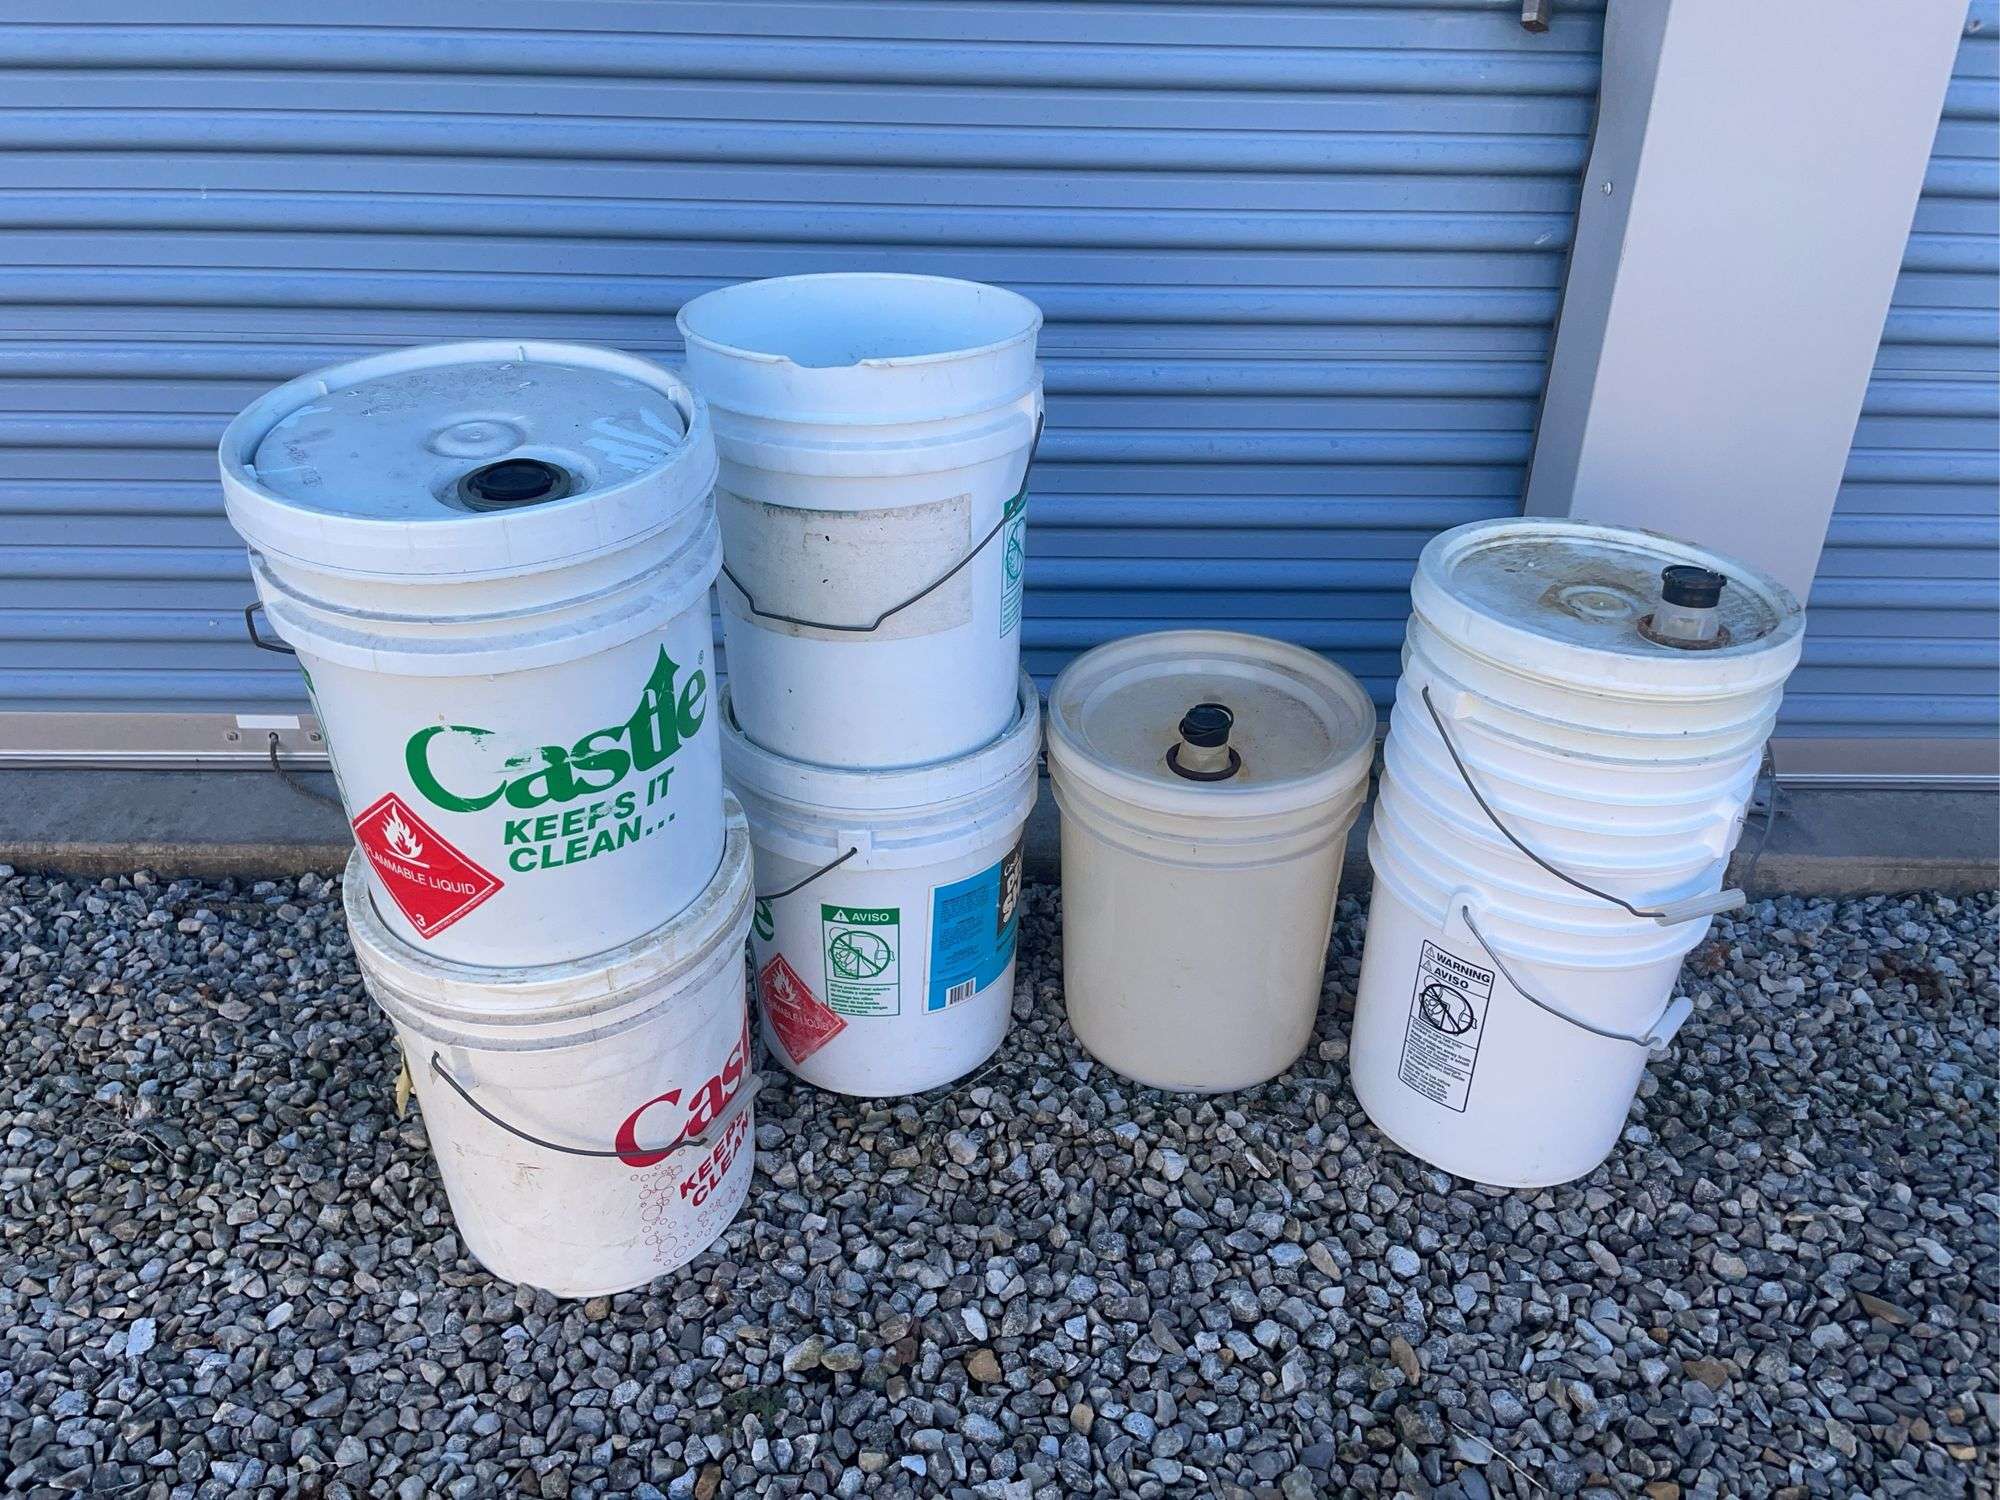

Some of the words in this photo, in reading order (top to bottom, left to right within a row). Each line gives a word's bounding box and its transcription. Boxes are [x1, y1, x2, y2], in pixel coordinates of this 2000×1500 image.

[405, 642, 708, 812] Castle
[503, 791, 636, 845] KEEPS
[646, 766, 675, 806] IT
[364, 841, 427, 886] FLAMMABLE
[428, 875, 476, 895] LIQUID
[414, 912, 427, 927] 3
[852, 912, 890, 923] AVISO
[1433, 967, 1470, 989] AVISO
[1436, 952, 1491, 983] WARNING
[692, 1110, 749, 1207] CLEAN
